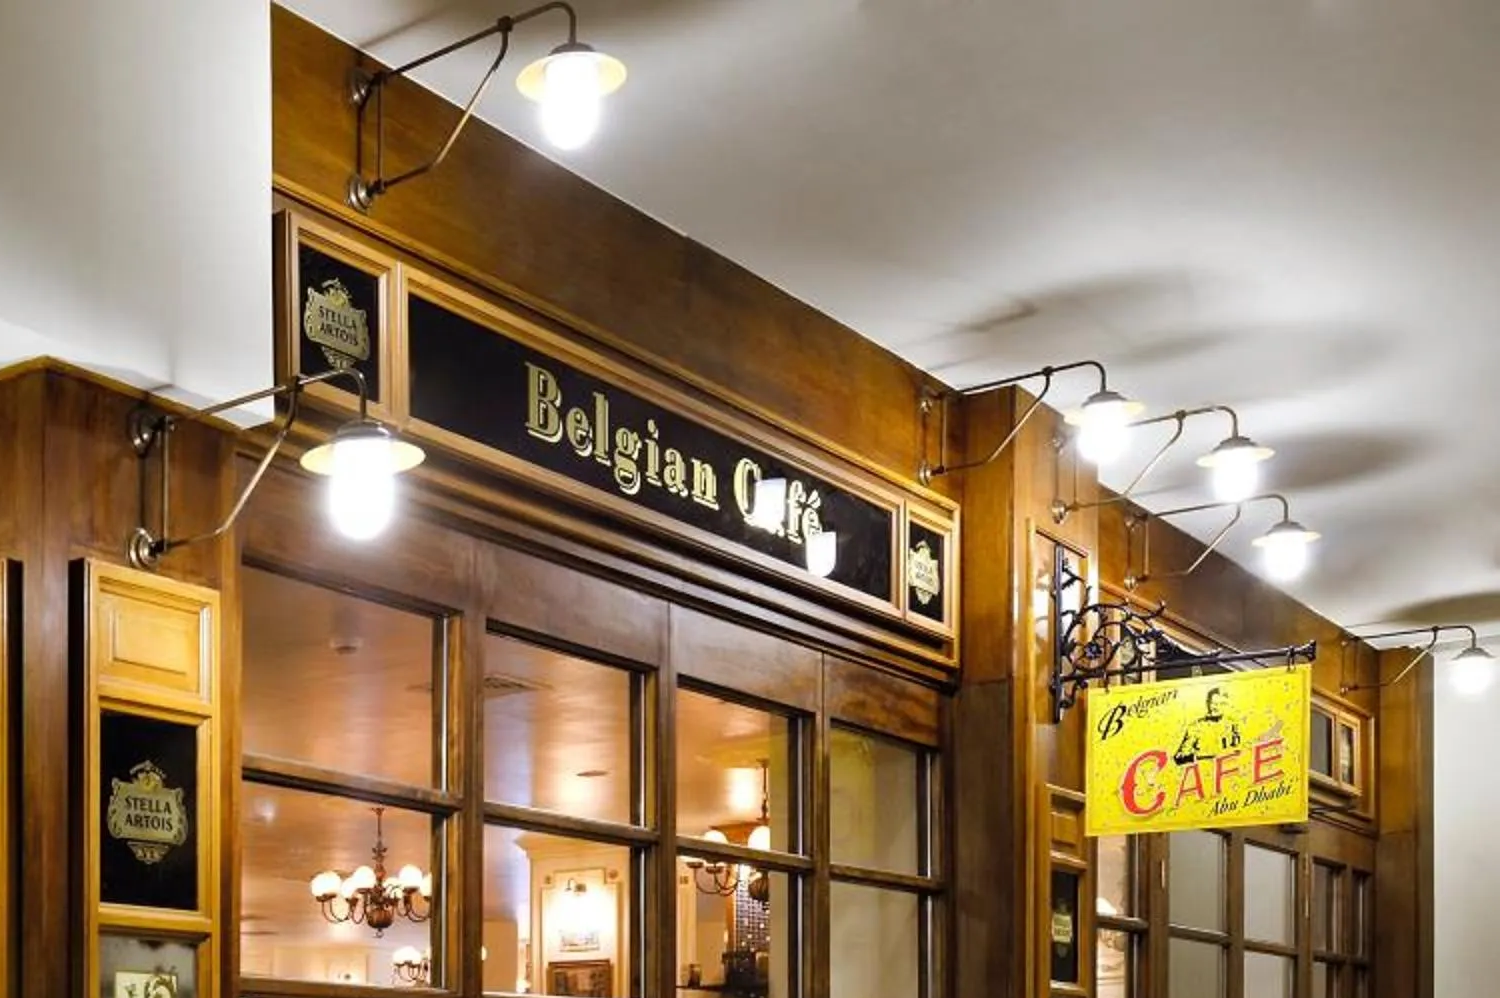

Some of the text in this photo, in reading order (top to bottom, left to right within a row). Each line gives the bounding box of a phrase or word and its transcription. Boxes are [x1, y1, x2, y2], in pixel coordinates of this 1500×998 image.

[524, 361, 823, 548] Belgian Cfé
[1097, 688, 1179, 741] Belgian
[124, 795, 173, 815] STELLA
[1208, 796, 1239, 817] Abu
[124, 813, 174, 833] ARTOIS
